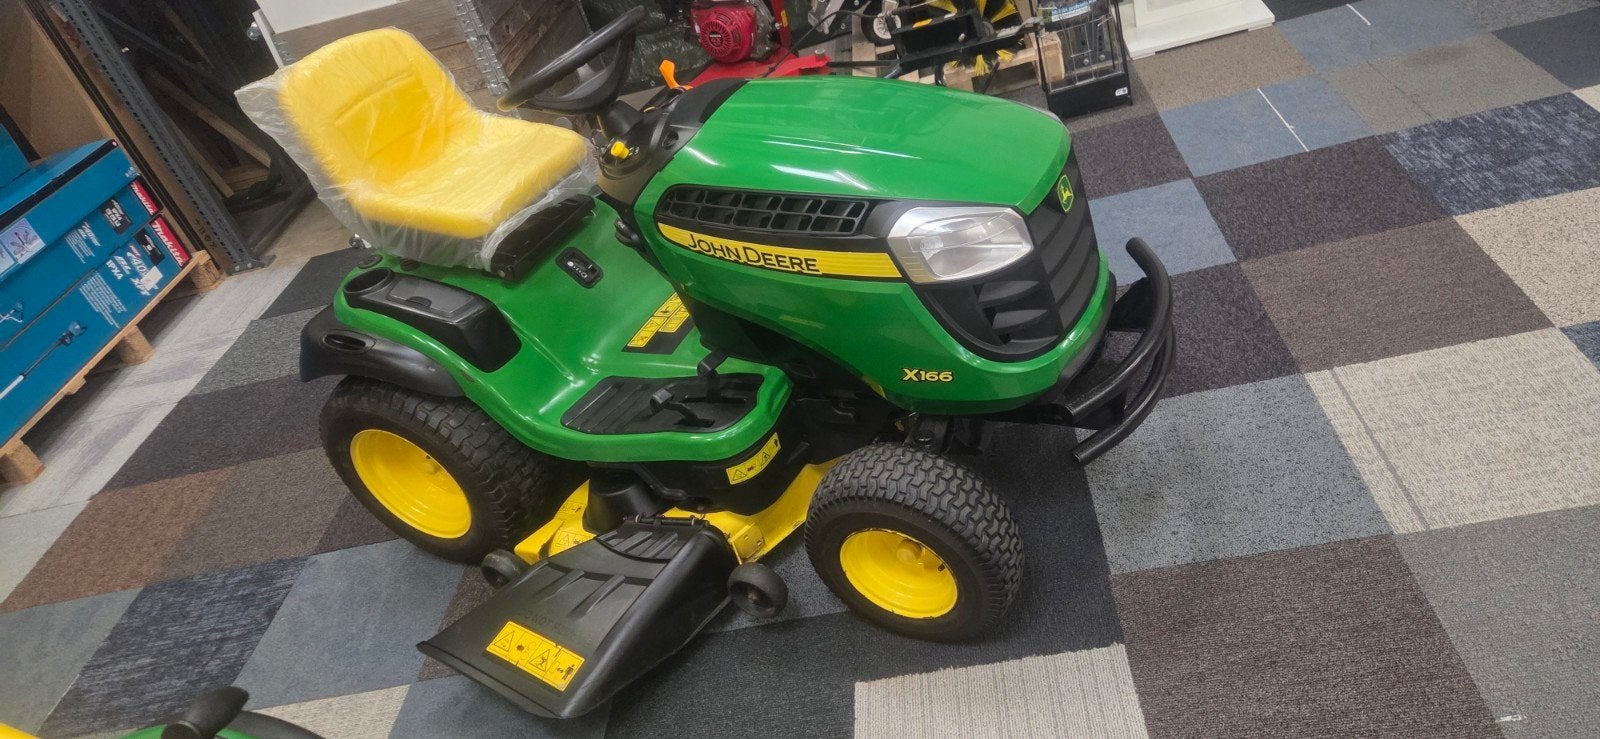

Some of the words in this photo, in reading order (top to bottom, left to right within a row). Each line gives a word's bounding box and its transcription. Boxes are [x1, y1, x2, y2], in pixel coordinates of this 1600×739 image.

[130, 181, 155, 216] makita
[151, 220, 185, 268] makita
[687, 233, 742, 262] JOHN
[743, 245, 820, 275] DEERE
[105, 259, 124, 280] IPX4
[902, 367, 954, 383] X166
